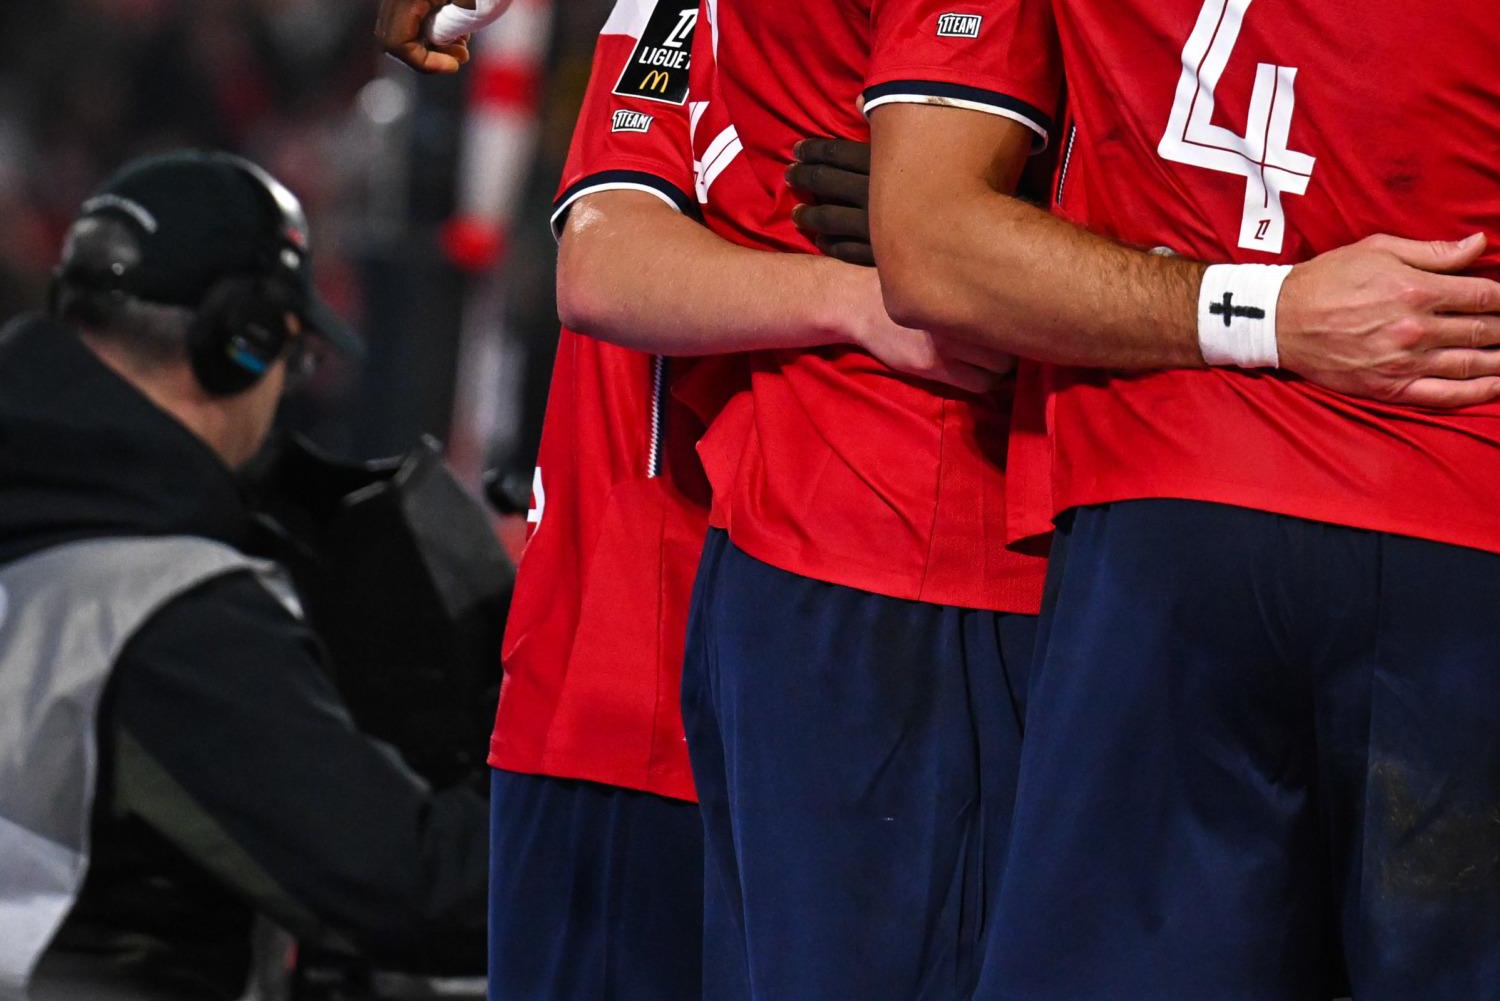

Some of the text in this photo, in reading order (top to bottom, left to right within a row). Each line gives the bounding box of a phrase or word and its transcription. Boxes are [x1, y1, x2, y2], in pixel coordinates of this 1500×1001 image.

[942, 16, 978, 34] 1TEAM
[638, 46, 688, 69] LIGUE
[615, 110, 648, 129] 1TEAM
